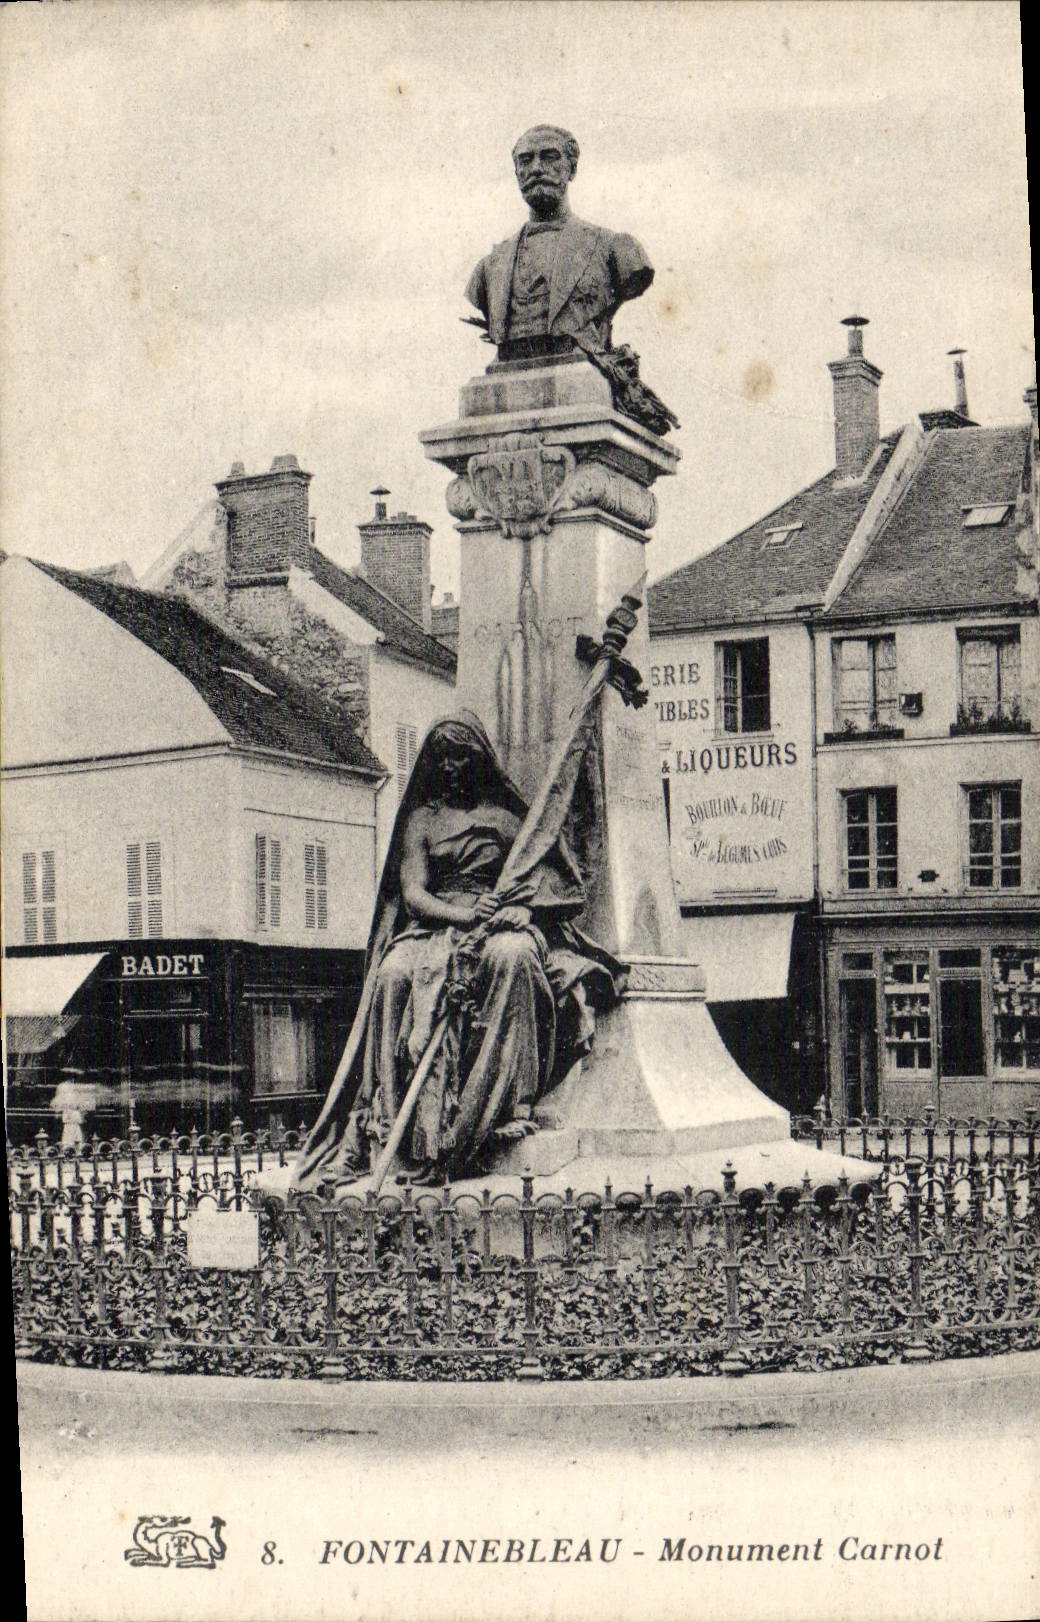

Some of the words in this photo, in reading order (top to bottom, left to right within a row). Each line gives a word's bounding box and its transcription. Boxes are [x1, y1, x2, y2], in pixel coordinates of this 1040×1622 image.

[474, 617, 583, 643] CANOT
[654, 698, 710, 722] IBLES
[661, 760, 671, 774] &
[675, 742, 798, 774] LIQUEURS
[122, 955, 203, 975] BADET
